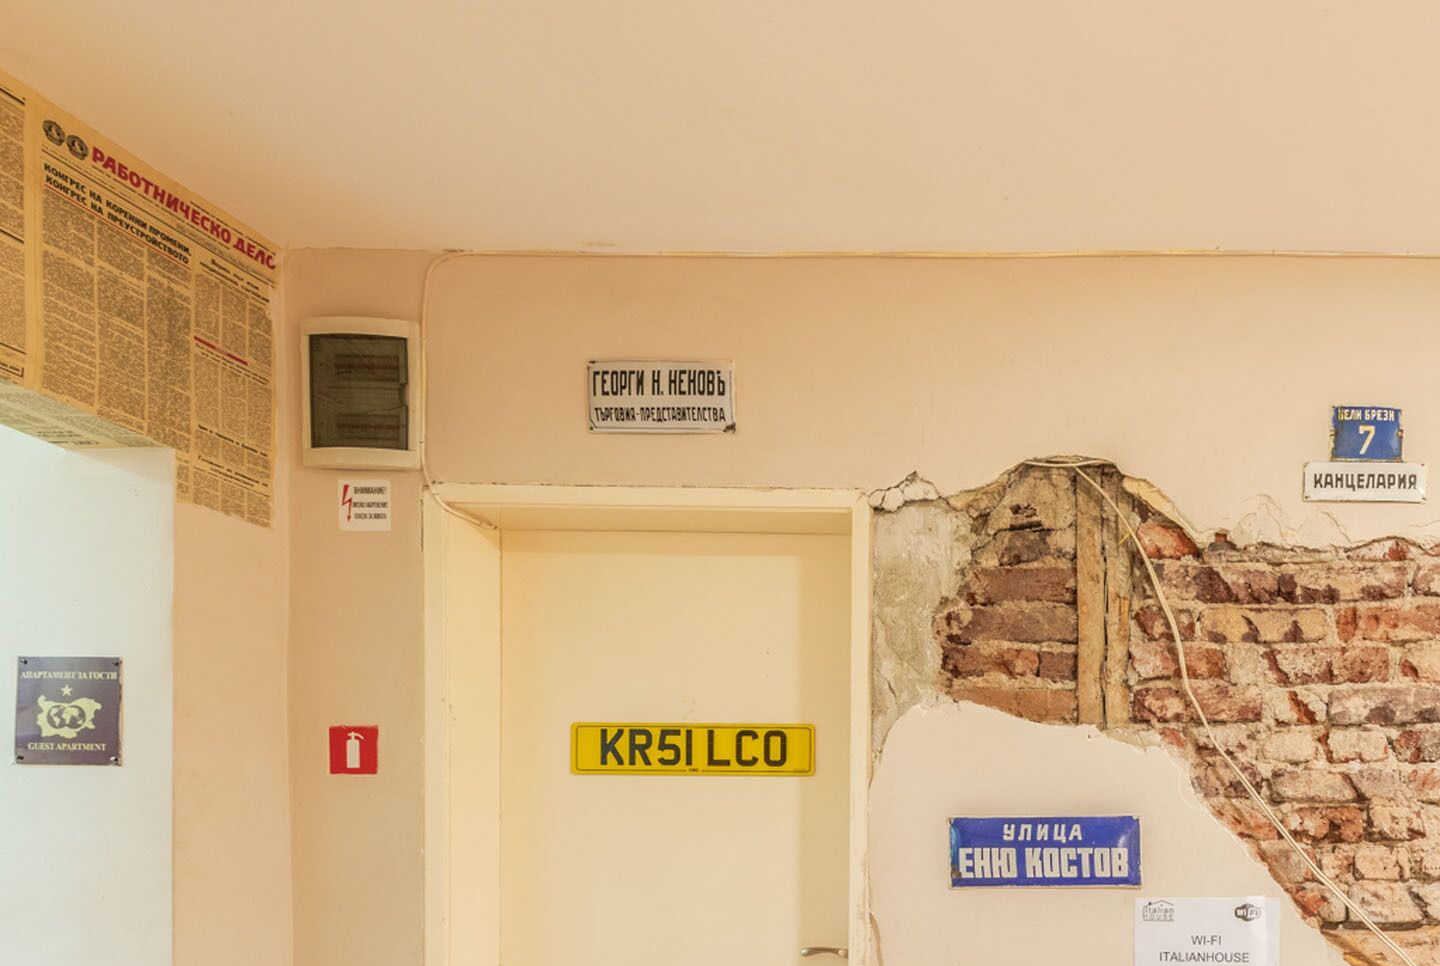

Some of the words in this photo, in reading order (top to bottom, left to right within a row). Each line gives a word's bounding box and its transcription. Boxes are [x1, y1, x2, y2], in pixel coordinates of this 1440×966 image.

[44, 163, 86, 194] КОНГРЕС
[89, 188, 103, 204] НА
[106, 200, 148, 230] КОРЕННИ
[45, 175, 87, 206] КОНГРЕС
[91, 200, 104, 216] НА
[91, 146, 232, 244] РАБОТНИЧЕСКО
[593, 370, 645, 396] ГЕОРГИ
[652, 370, 664, 396] Н.
[669, 369, 726, 396] НЕНОВЪ
[1365, 409, 1395, 422] БРЕЗИ
[1358, 425, 1376, 455] 7
[1313, 473, 1417, 492] КАНЦЕЛАРИЯ
[27, 743, 55, 751] GUEST
[57, 743, 107, 751] APARTMENT
[600, 728, 693, 766] KR51
[707, 729, 787, 767] LCO
[1002, 823, 1083, 843] УЛИЦА
[958, 848, 1017, 879] ЕНЮ
[1025, 847, 1129, 879] КОСТОВ
[1191, 935, 1222, 946] WI-FI
[1159, 952, 1250, 964] ITALIANHOUSE
